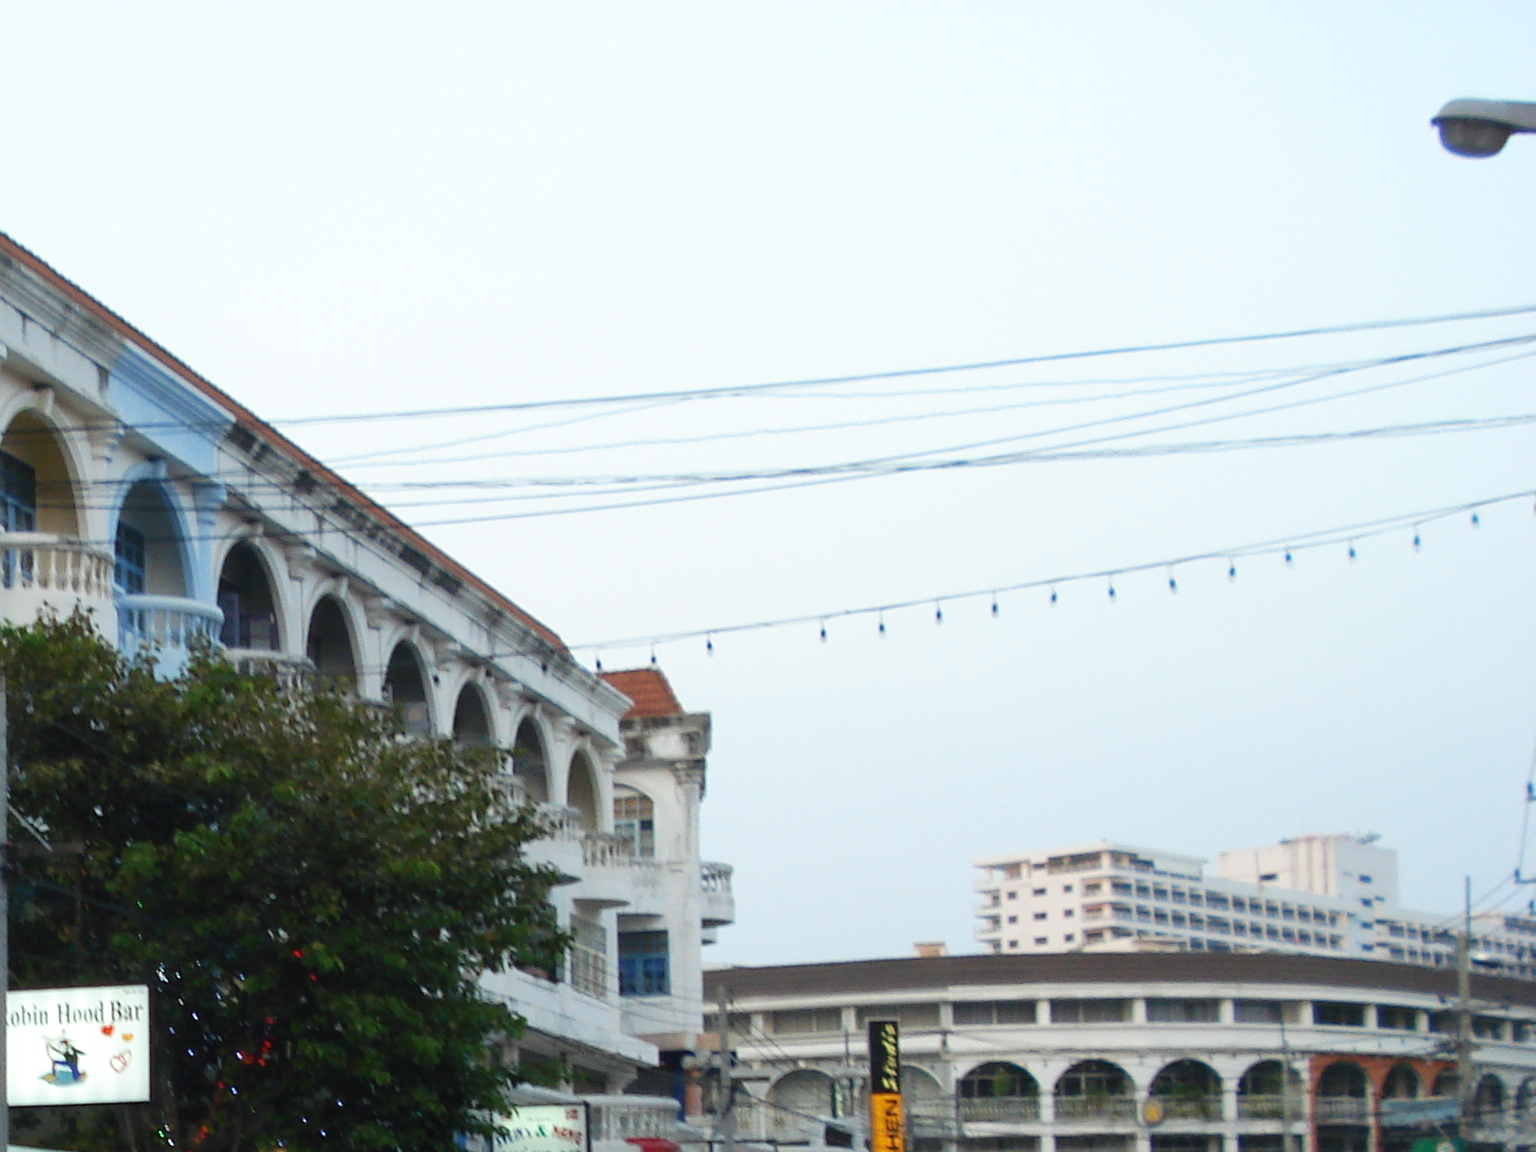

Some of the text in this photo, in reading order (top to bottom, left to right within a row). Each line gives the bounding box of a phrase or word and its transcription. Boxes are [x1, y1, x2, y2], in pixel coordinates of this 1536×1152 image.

[5, 999, 144, 1027] obin Hood Bar
